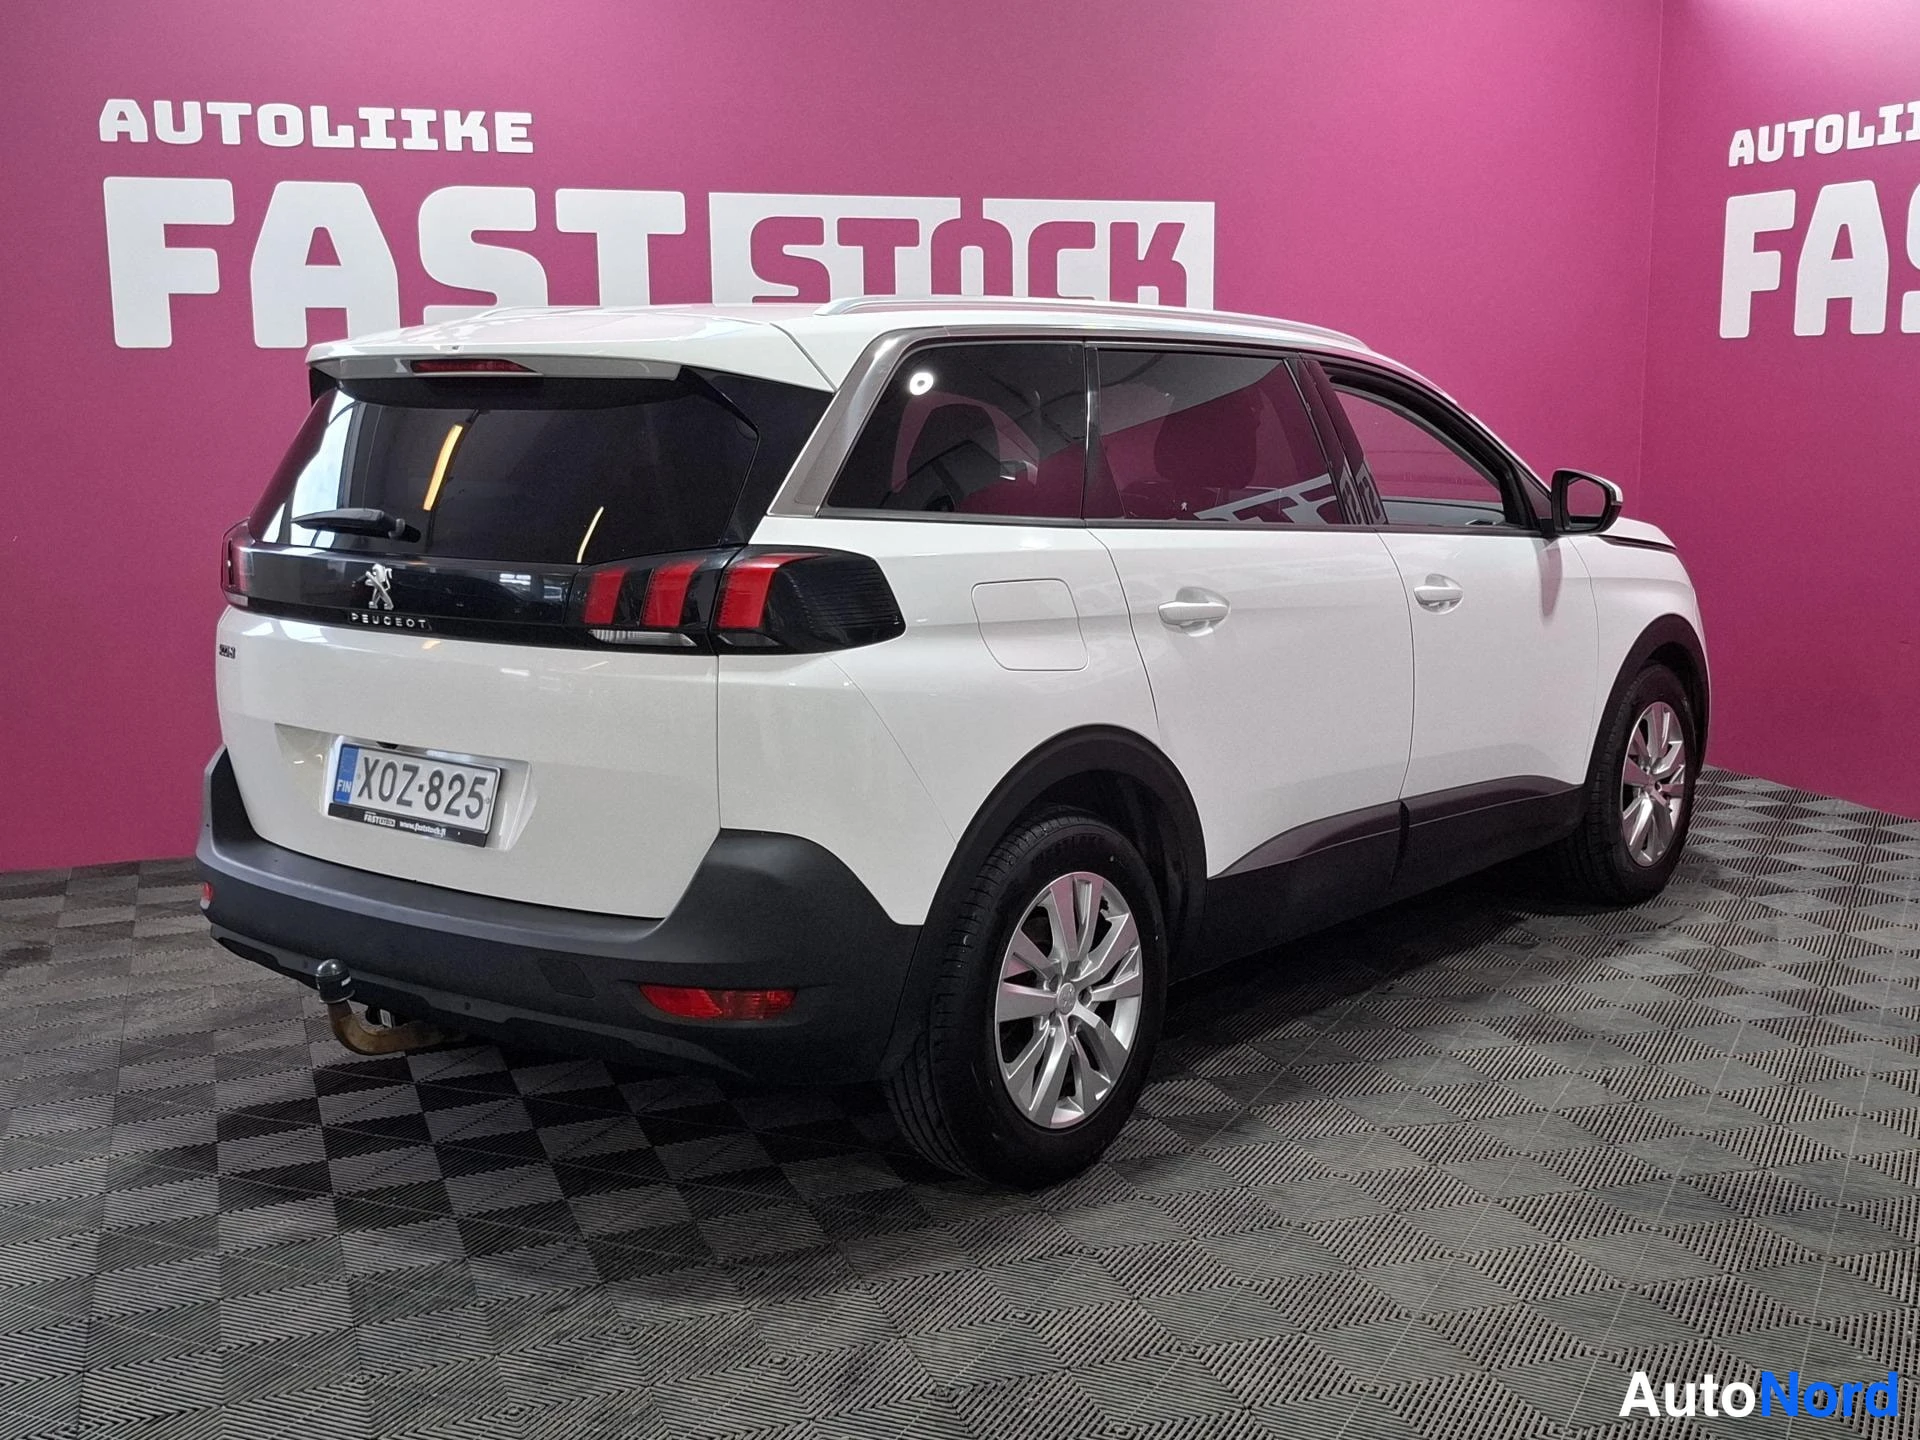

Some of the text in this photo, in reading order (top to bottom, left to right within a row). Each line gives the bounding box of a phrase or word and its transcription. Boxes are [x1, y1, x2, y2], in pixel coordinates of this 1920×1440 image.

[99, 98, 534, 154] AUTOLIIKE
[1719, 179, 1920, 338] FA
[351, 612, 426, 629] PEUGEOT
[336, 778, 353, 793] FIN
[357, 756, 488, 820] XOZ-825
